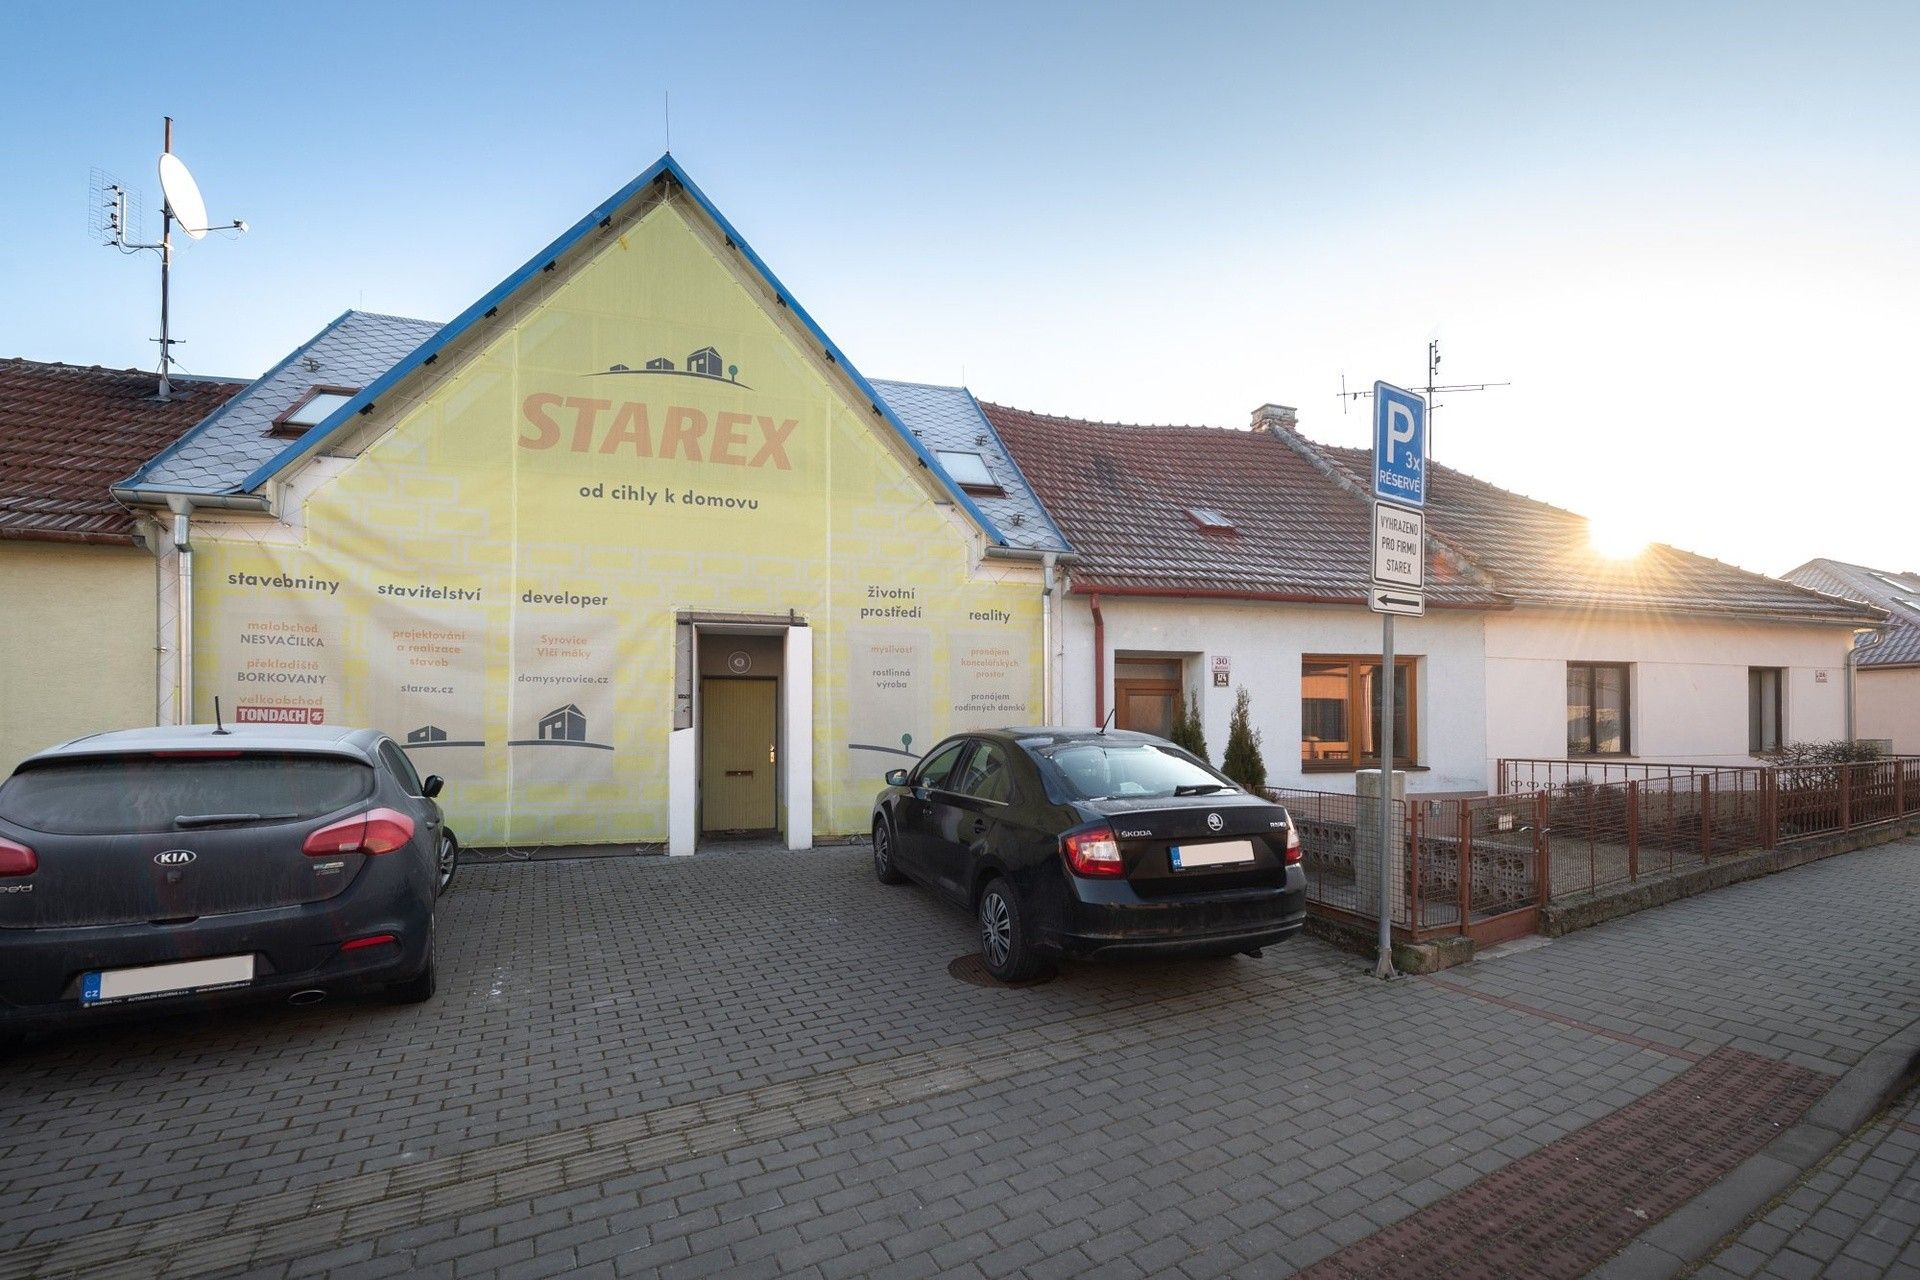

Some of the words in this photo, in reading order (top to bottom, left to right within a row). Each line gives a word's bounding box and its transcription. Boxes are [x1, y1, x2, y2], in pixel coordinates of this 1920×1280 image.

[517, 392, 799, 471] STAREX
[1387, 400, 1415, 463] P
[1405, 451, 1420, 471] 3x
[1380, 468, 1420, 493] RÉSERVÉ
[579, 483, 603, 499] od
[611, 485, 657, 506] cihly
[665, 488, 675, 503] k
[682, 490, 759, 510] domovu
[1381, 515, 1419, 536] VYHRAZENO
[1381, 536, 1395, 551] PRO
[1397, 540, 1417, 555] FIRMU
[1386, 559, 1412, 575] STAREX
[228, 572, 339, 595] stavebniny
[378, 584, 481, 601] stavitelství
[522, 589, 608, 608] developer
[867, 585, 915, 599] životní
[860, 605, 922, 619] prostředí
[969, 609, 1011, 624] reality
[248, 621, 319, 633] malobchod
[240, 633, 325, 648] NESVAČILKA
[392, 629, 465, 641] projektování
[540, 634, 587, 646] Syrovice
[396, 644, 404, 652] a
[408, 643, 461, 653] realizace
[871, 645, 912, 655] myslivost
[247, 658, 319, 671] překladiště
[410, 658, 449, 667] staveb
[237, 671, 327, 684] BORKOVANY
[518, 673, 609, 685] domysyrovice.cz
[872, 668, 911, 677] rostlinná
[400, 684, 454, 694] starex.cz
[876, 679, 907, 689] výroba
[239, 694, 323, 706] velkoobchod
[971, 692, 1010, 701] pronájem
[954, 703, 996, 713] rodinných
[238, 708, 306, 723] TONDACH
[161, 852, 189, 863] KIA
[84, 989, 99, 998] CZ
